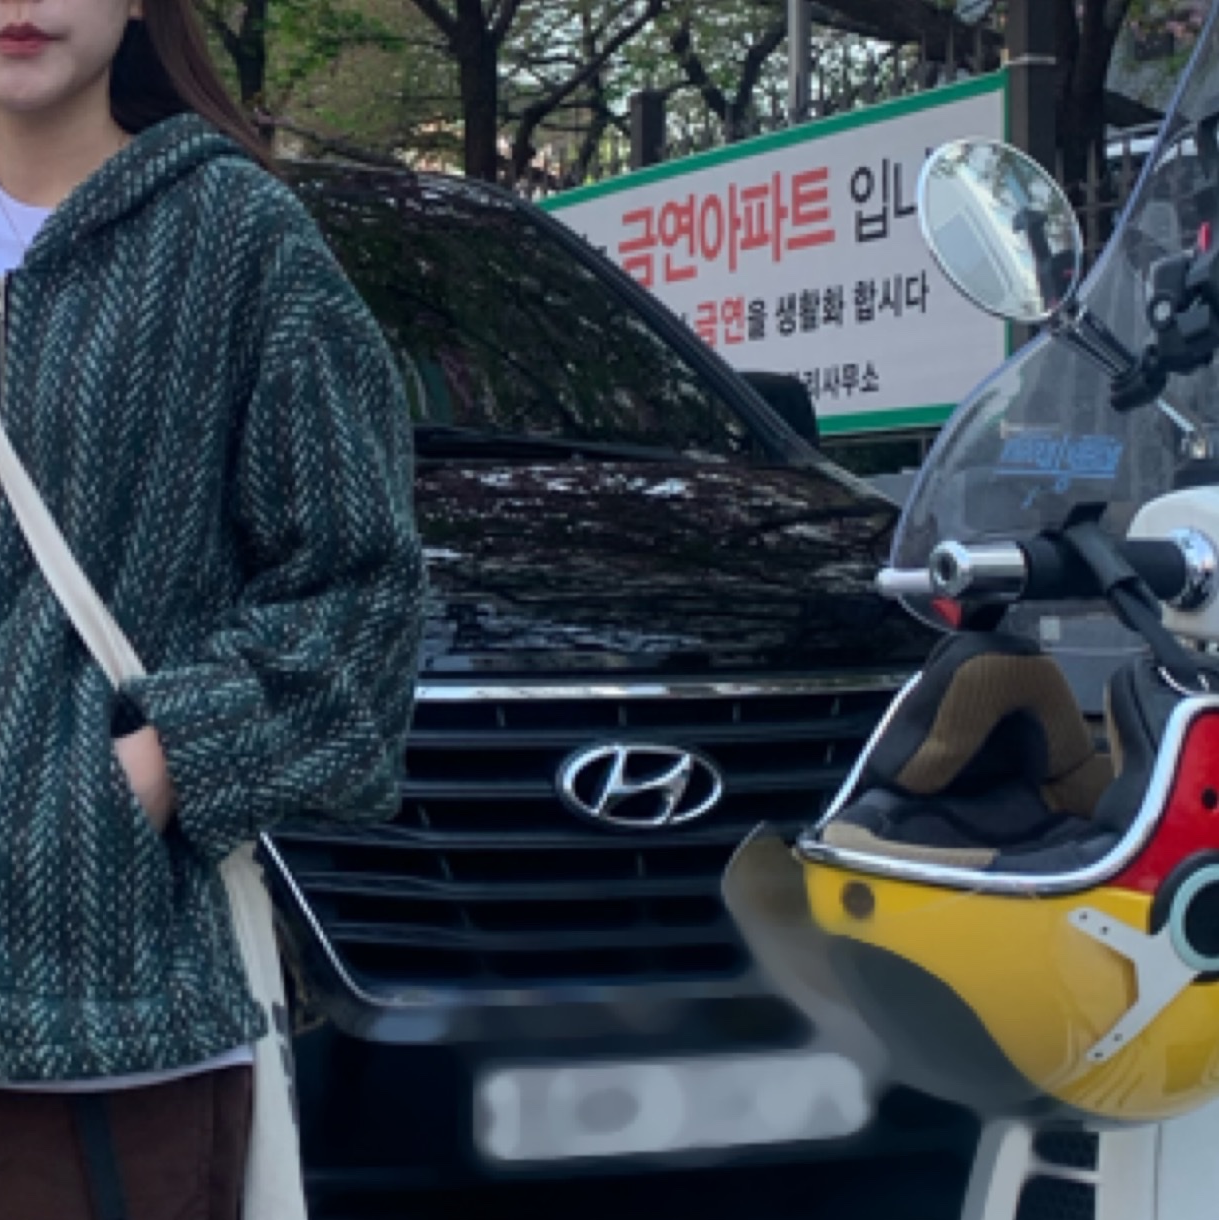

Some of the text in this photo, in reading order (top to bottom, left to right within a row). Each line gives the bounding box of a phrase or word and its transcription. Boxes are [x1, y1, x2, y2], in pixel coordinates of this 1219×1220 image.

[618, 167, 836, 288] 금연아파트
[694, 269, 930, 346] 금연을 생활화 합시다
[796, 361, 879, 400] 리사무소
